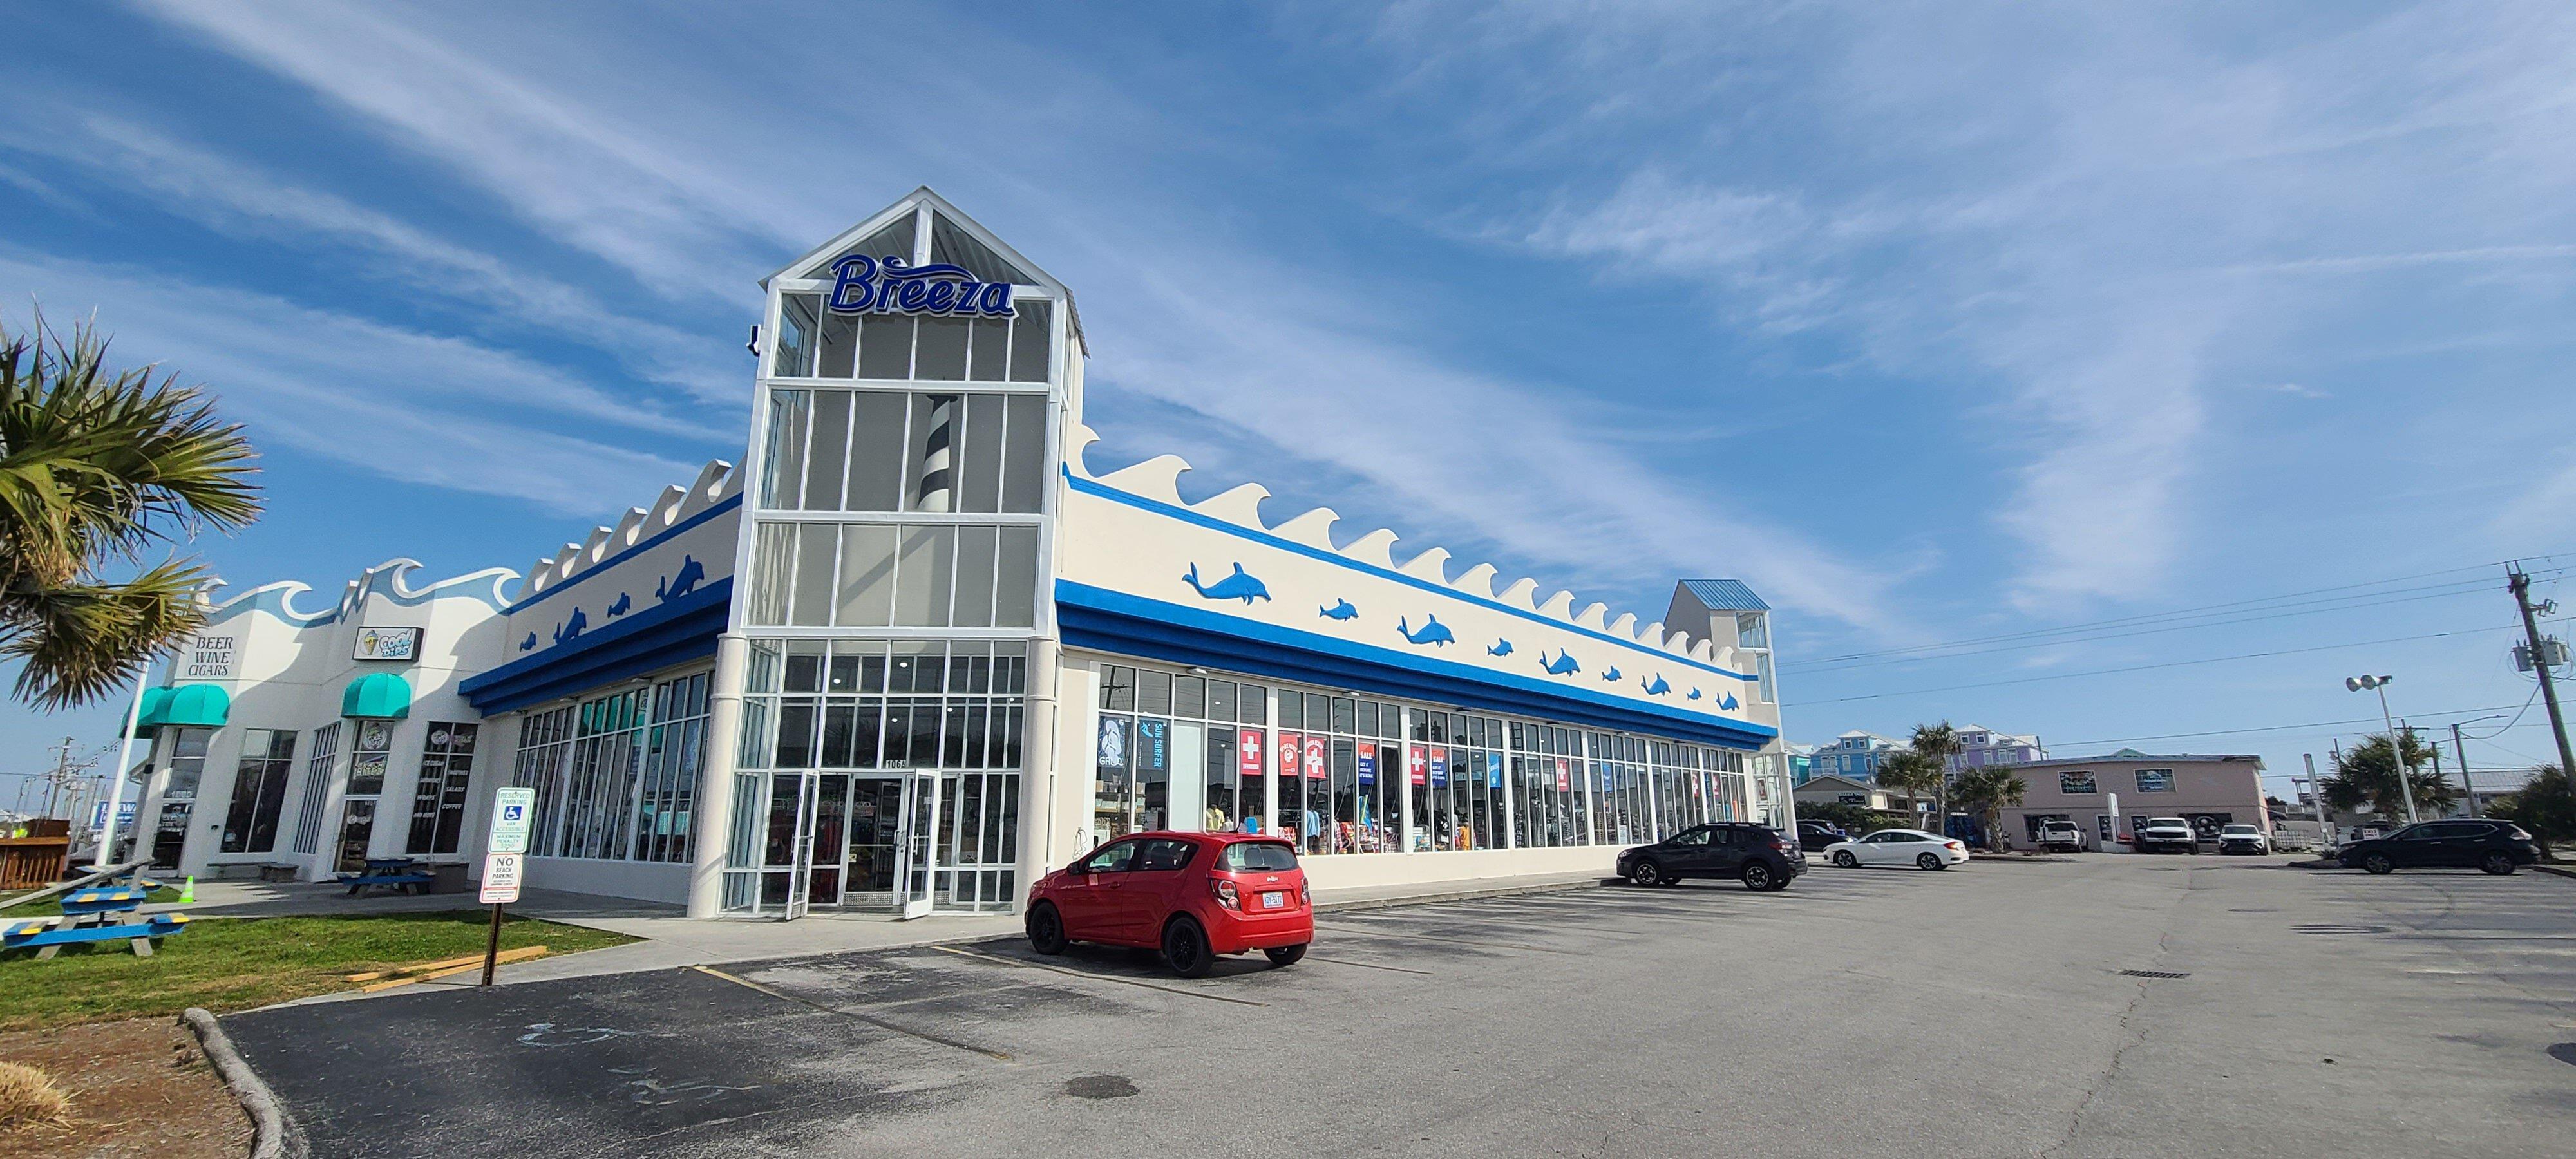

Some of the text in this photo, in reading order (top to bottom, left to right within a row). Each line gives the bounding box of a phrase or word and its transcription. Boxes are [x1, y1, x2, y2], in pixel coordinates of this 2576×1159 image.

[828, 254, 1016, 316] Breeza
[195, 636, 234, 650] BEER
[195, 651, 231, 664] WINE
[188, 664, 229, 676] CIGARS
[1153, 739, 1162, 768] SURFER
[496, 858, 514, 867] NO
